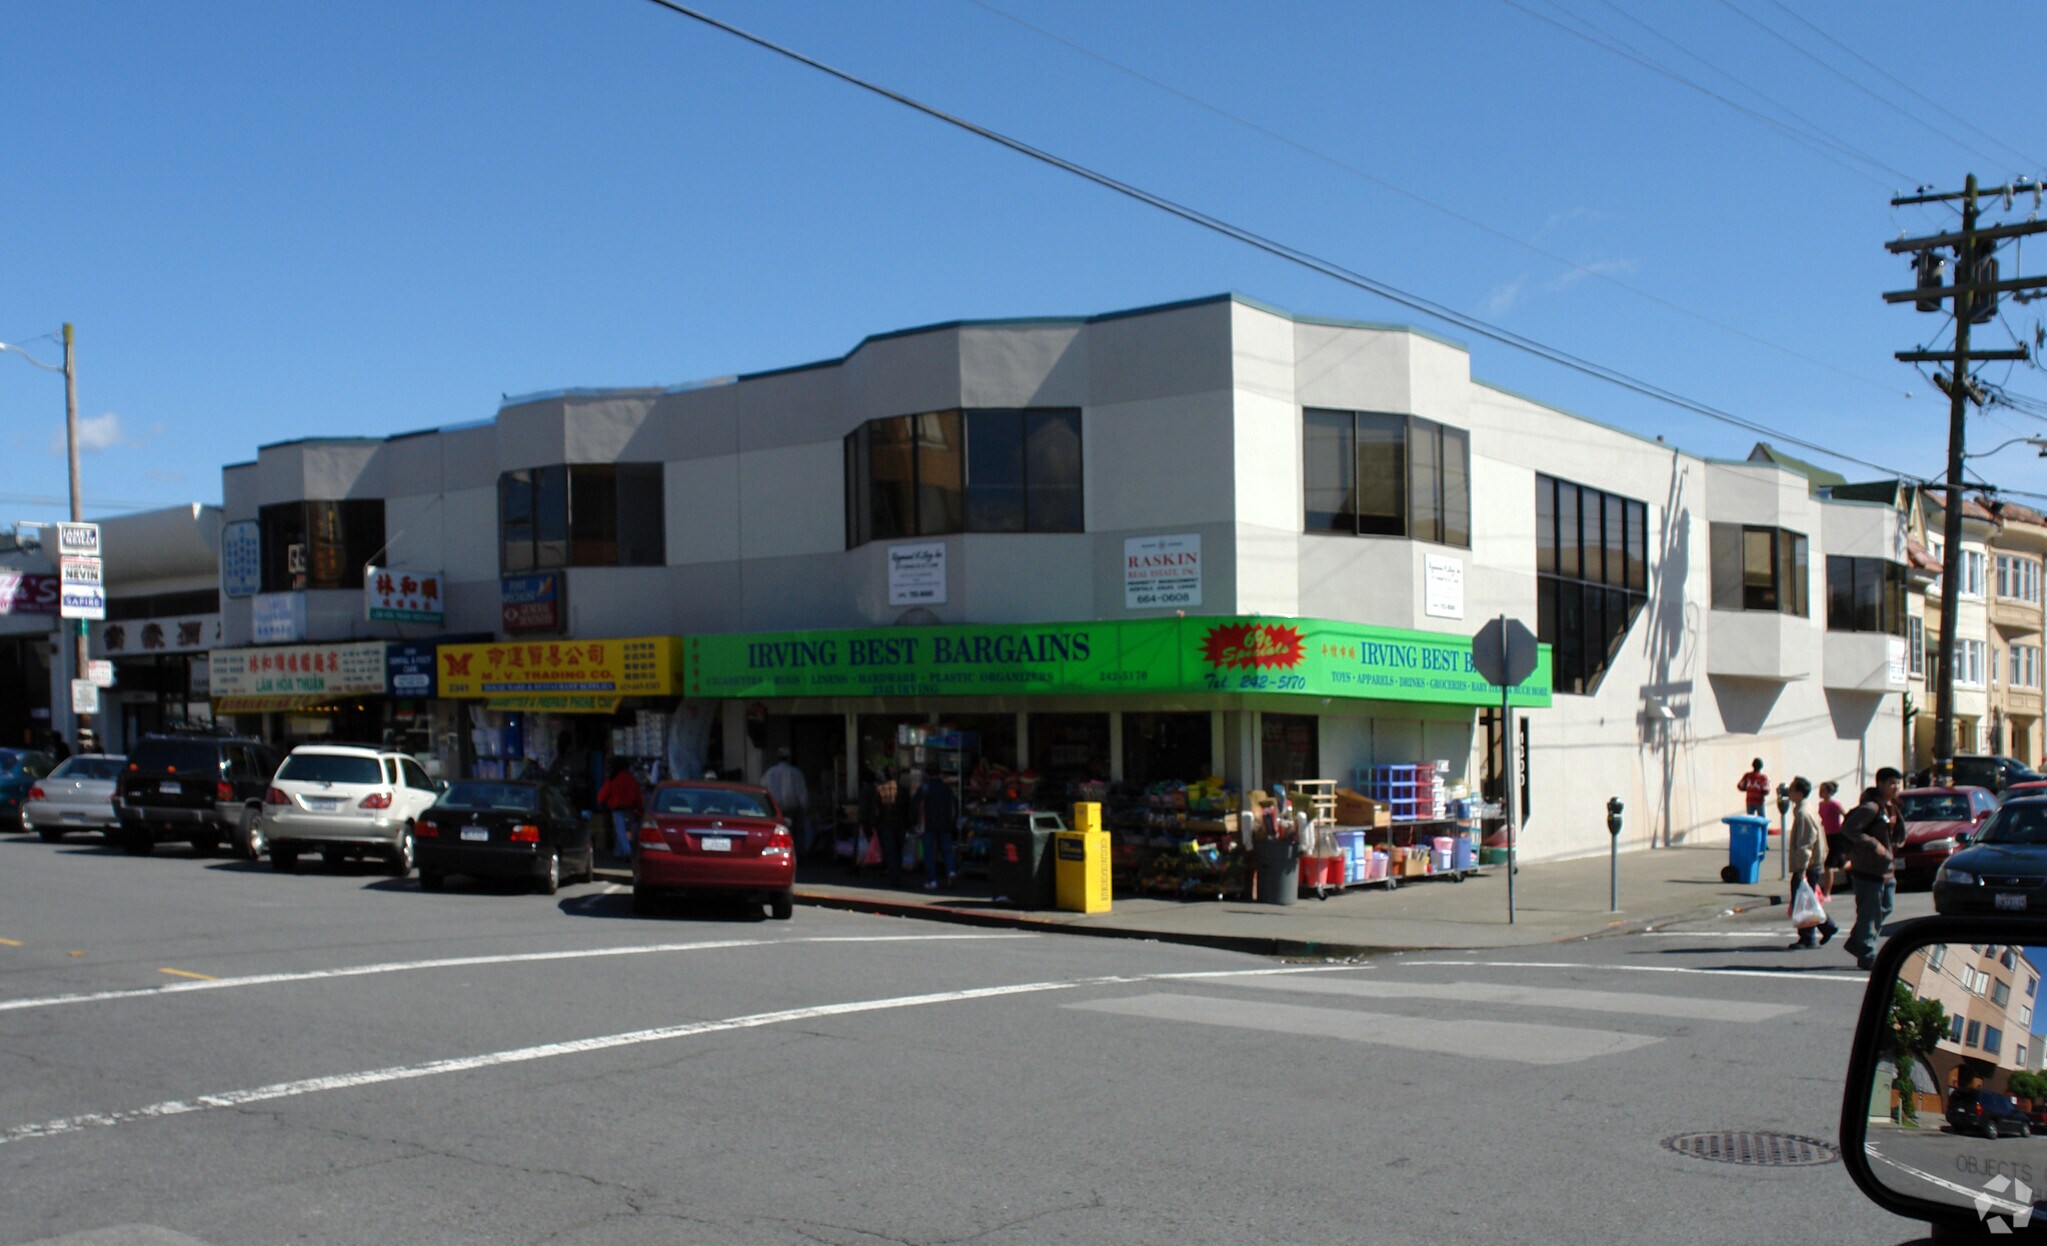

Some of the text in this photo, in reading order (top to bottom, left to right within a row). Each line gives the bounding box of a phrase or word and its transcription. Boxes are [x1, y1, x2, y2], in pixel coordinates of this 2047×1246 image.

[63, 527, 91, 538] JANET
[65, 536, 96, 546] REILLY
[1128, 552, 1197, 568] RASKIN
[66, 569, 98, 580] NEVIN
[1128, 570, 1147, 578] REAL
[1137, 592, 1190, 603] 664-0608
[748, 633, 1091, 669] IRVING BEST BARGAINS
[1220, 642, 1290, 664] Specials
[1360, 641, 1418, 669] IRVING
[1421, 647, 1460, 673] BEST
[524, 670, 586, 680] TRADING
[591, 669, 615, 679] CO.
[858, 673, 918, 684] HARDWARE
[929, 672, 974, 683] PLASTIC
[980, 671, 1054, 682] ORGANIZERS
[1099, 670, 1148, 682] 242-5170
[1240, 674, 1306, 690] 242-5170
[1331, 671, 1352, 683] TOYS
[1356, 673, 1395, 687] APPARELS
[1399, 676, 1425, 688] DRINKS
[1429, 679, 1467, 691] GROCERIES
[898, 684, 939, 694] IRVING
[1956, 1154, 2033, 1182] OBJECTS
